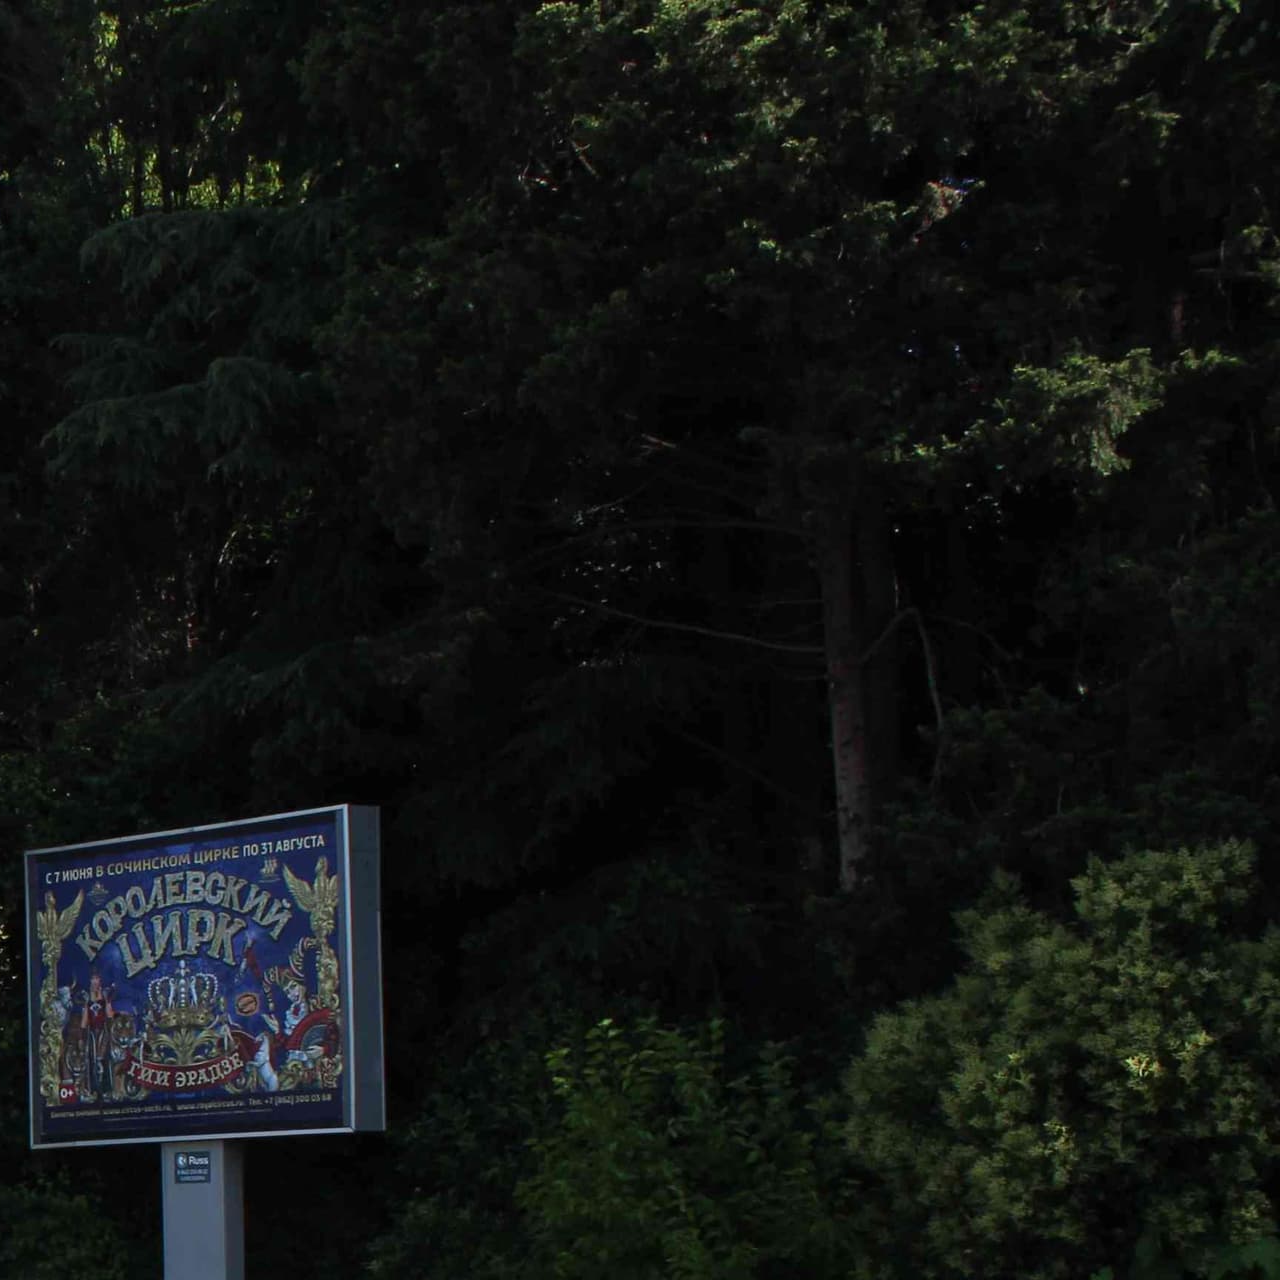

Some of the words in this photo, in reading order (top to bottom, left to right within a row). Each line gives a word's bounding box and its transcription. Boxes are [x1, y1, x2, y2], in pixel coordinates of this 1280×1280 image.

[45, 872, 53, 884] С
[54, 871, 61, 883] 7
[62, 866, 93, 882] ИЮНЯ
[95, 865, 104, 877] В
[107, 853, 191, 876] СОЧИНСКОМ
[194, 846, 240, 864] ЦИРКЕ
[243, 844, 259, 857] ПО
[261, 841, 273, 855] 31
[275, 835, 325, 852] АВГУСТА
[75, 870, 292, 961] КОРОЛЕВСКИЙ
[116, 909, 247, 978] ЦИРК
[60, 1088, 75, 1099] 0+
[175, 1052, 244, 1088] ЭРАДЗЕ
